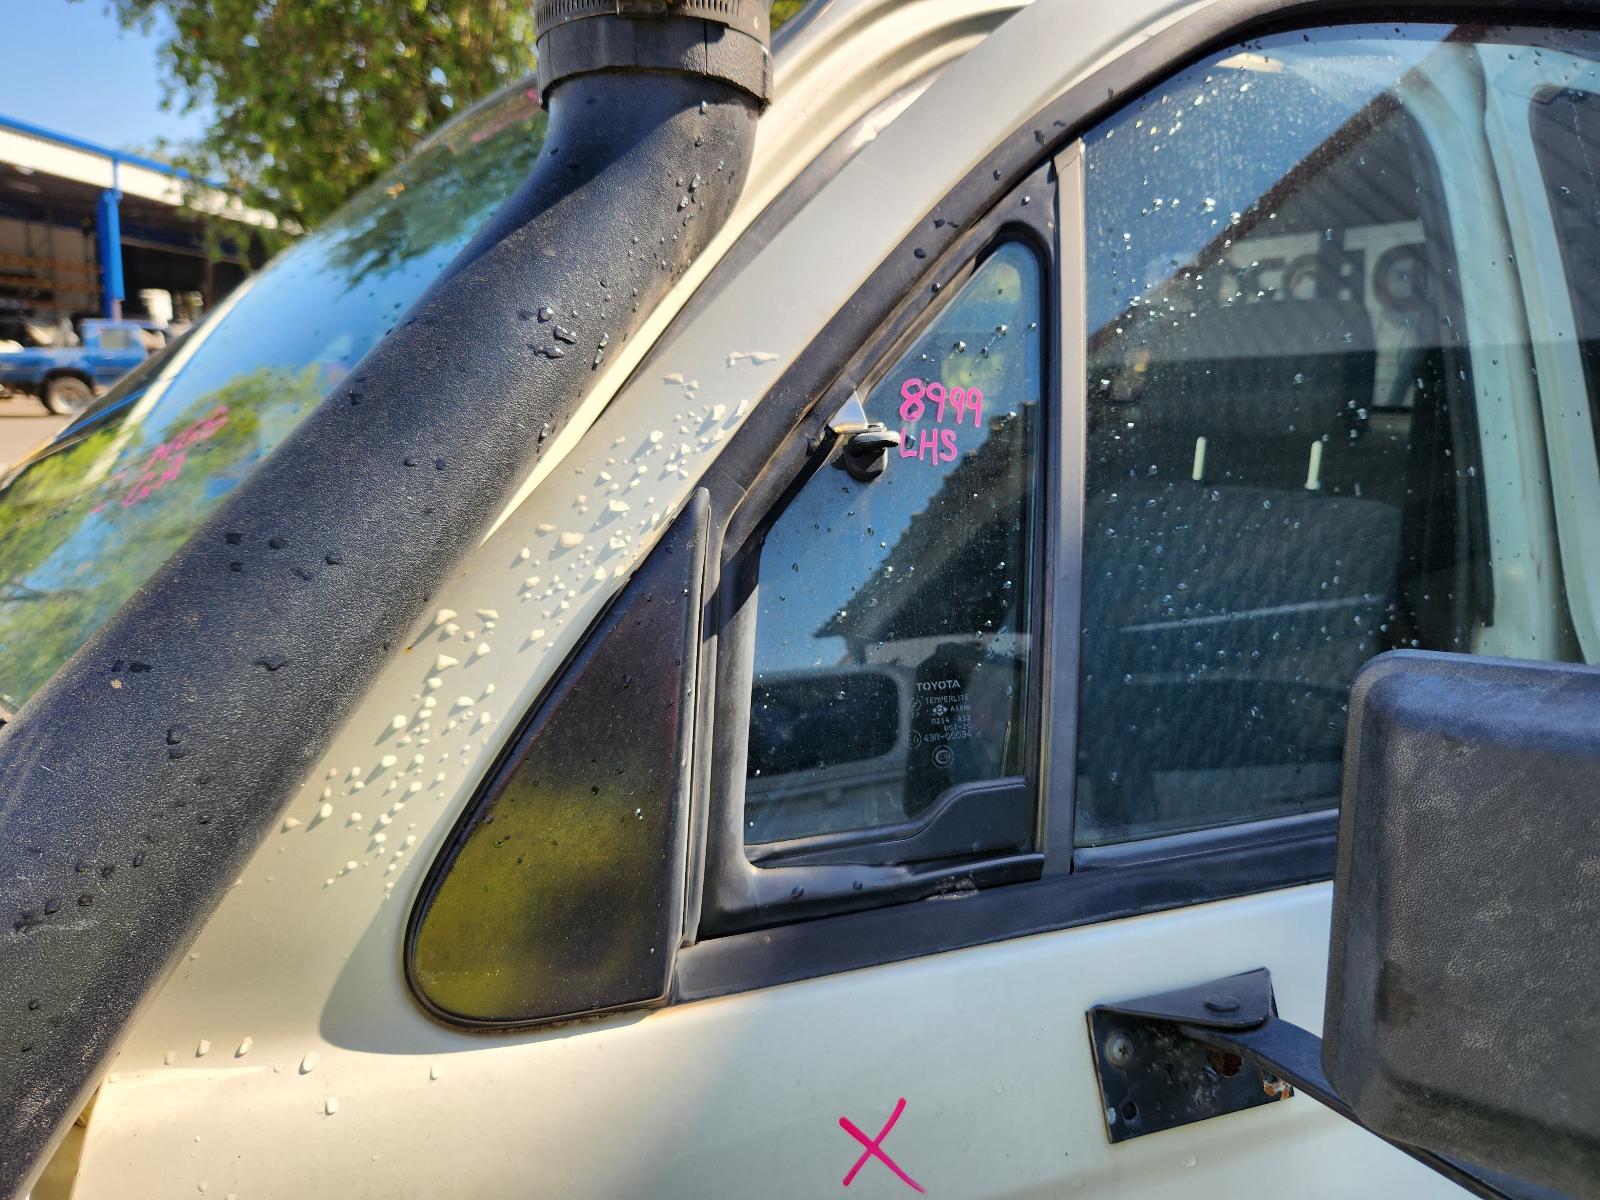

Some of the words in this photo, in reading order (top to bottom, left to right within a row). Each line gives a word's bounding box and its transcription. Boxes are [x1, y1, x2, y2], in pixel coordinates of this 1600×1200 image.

[900, 378, 983, 428] 8999
[900, 427, 958, 466] LHS
[916, 680, 960, 691] TOYOTA
